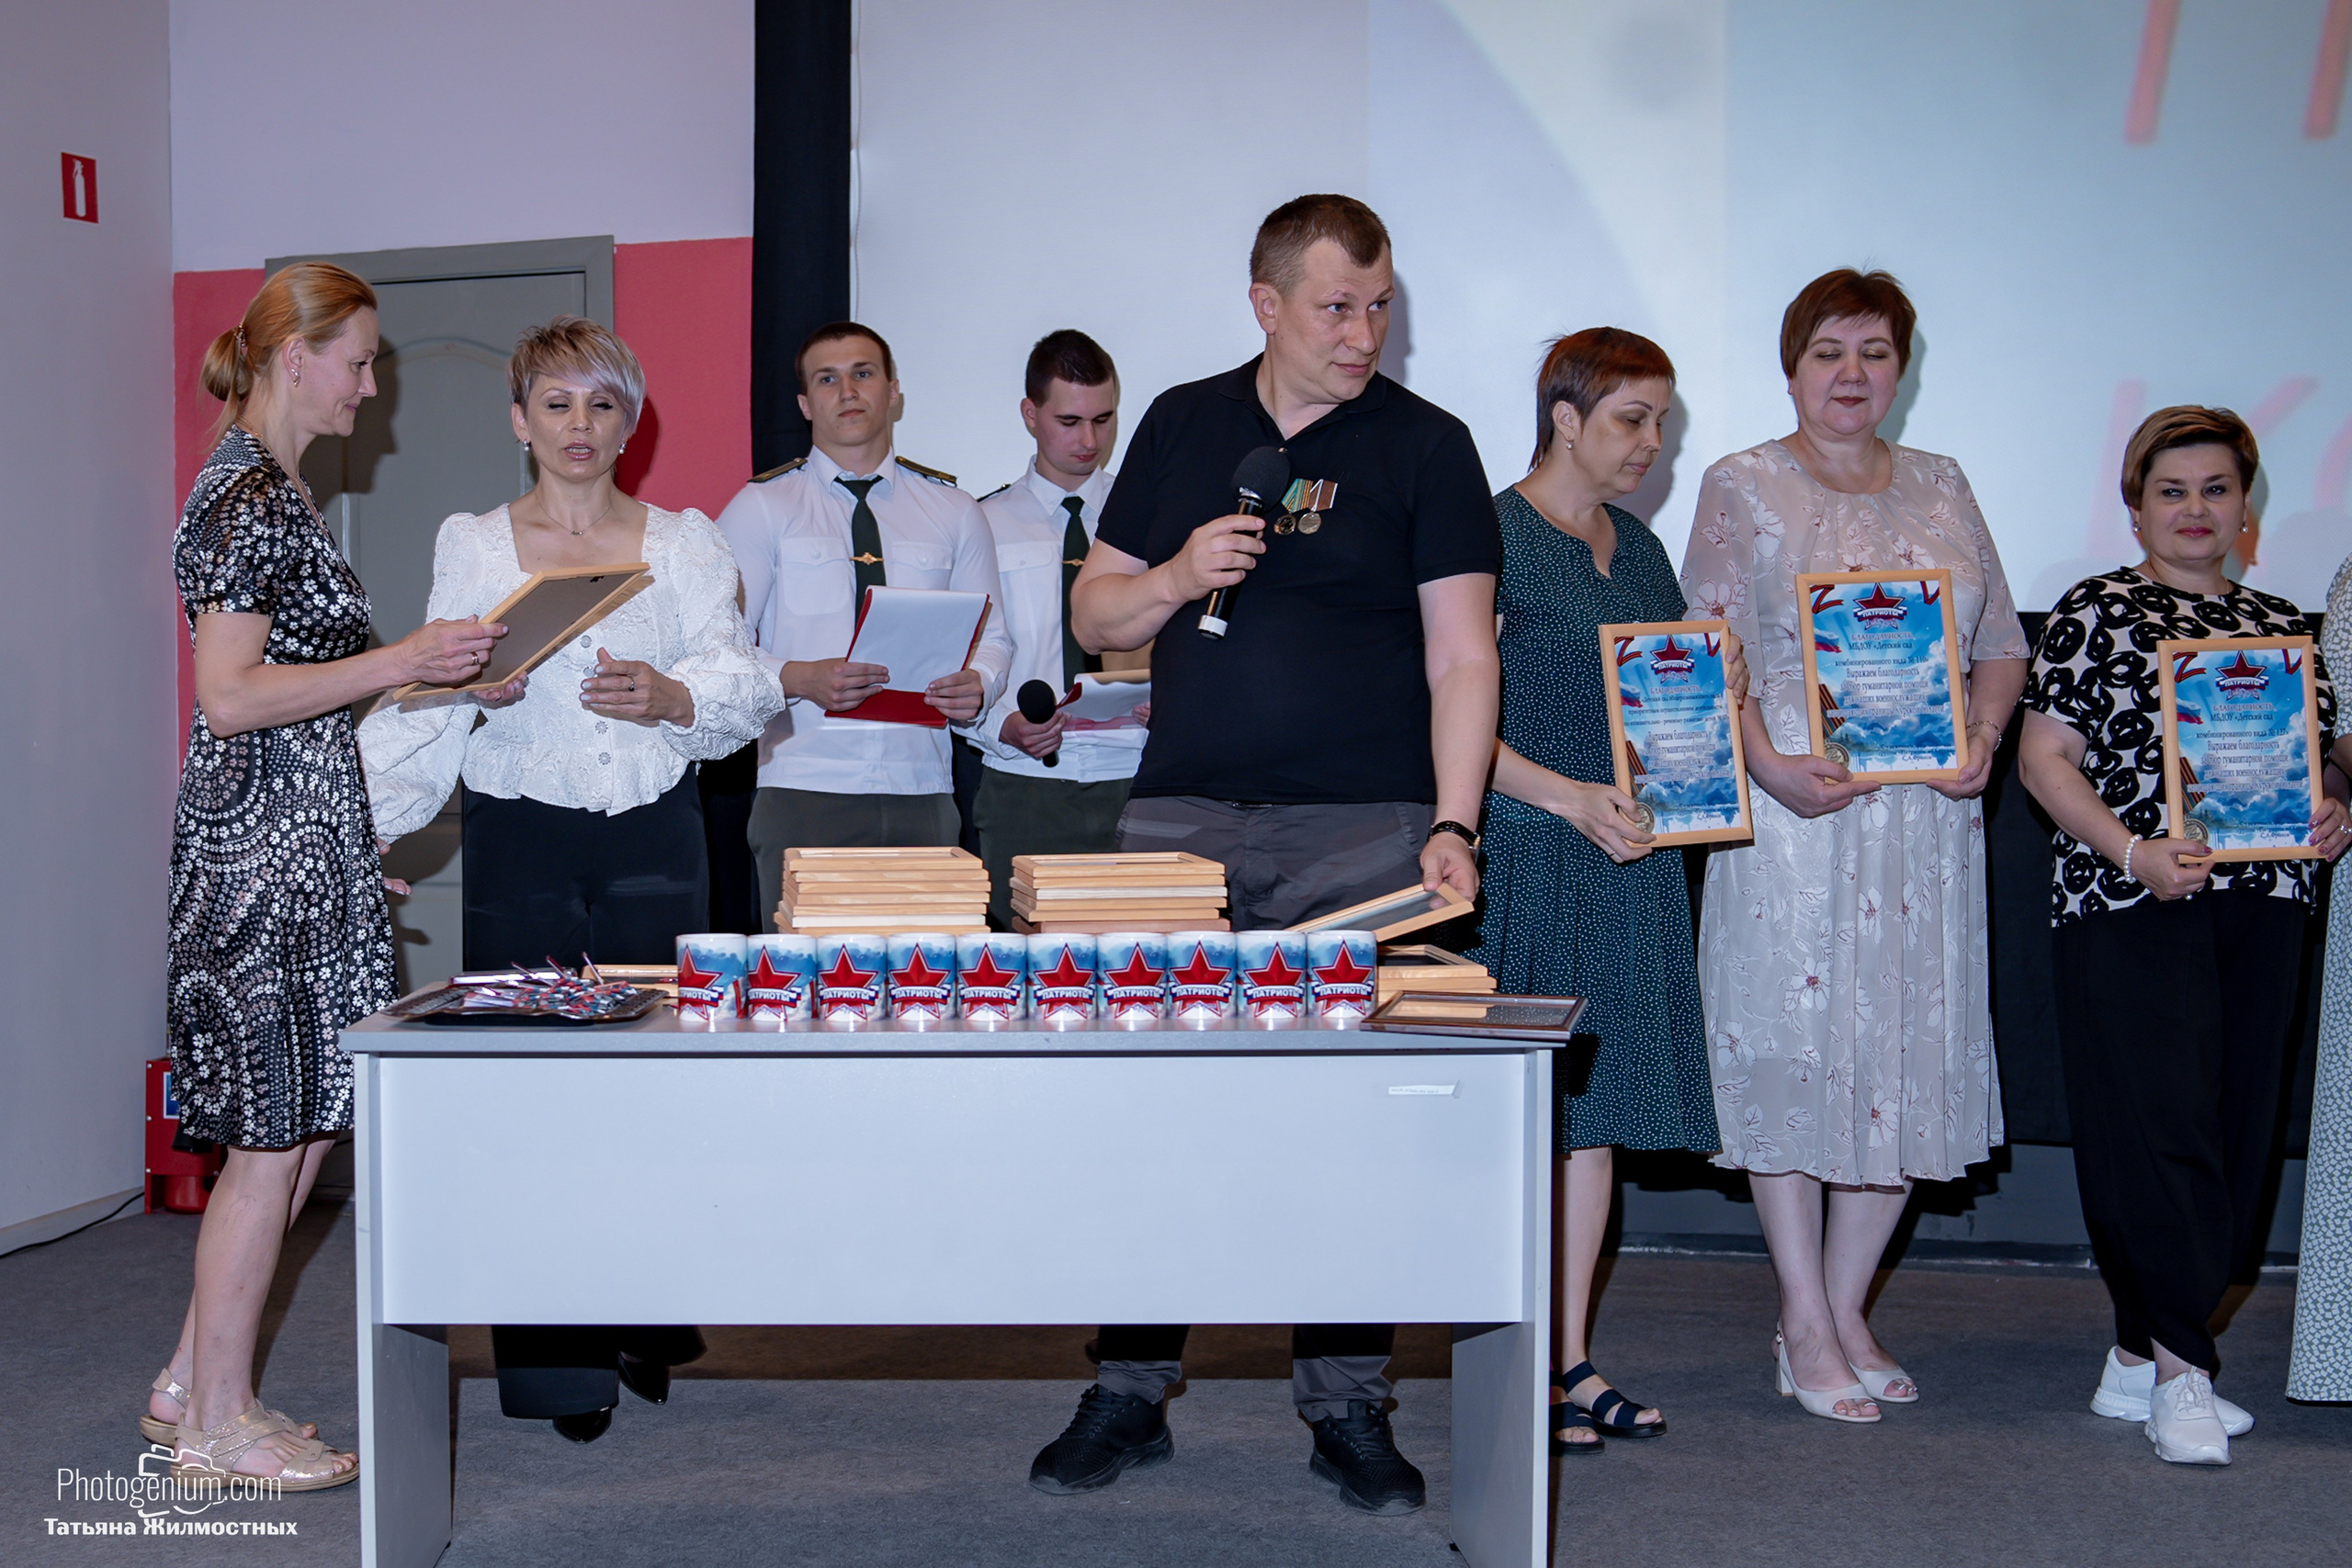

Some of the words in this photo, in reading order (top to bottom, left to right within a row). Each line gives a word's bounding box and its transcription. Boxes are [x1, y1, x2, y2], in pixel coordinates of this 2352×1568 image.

[1862, 609, 1899, 617] ПАТРИОТЫ
[1873, 641, 1902, 650] «Детский
[1658, 661, 1689, 670] ПАТРИОТЫ
[1835, 658, 1892, 667] комбинированного
[1846, 669, 1877, 679] Выражаем
[1877, 667, 1920, 678] благодарность
[1861, 681, 1903, 693] гуманитарной
[2224, 678, 2261, 687] ПАТРИОТЫ
[2210, 714, 2233, 722] МБДОУ
[2234, 713, 2262, 722] «Детский
[2196, 729, 2252, 739] комбинированного
[2207, 741, 2237, 752] Выражаем
[2238, 739, 2280, 751] благодарность
[823, 989, 870, 1000] ПАТРИОТЫ
[895, 988, 943, 999] ПАТРИОТЫ
[964, 988, 1012, 999] ПАТРИОТЫ
[1042, 988, 1090, 999] ПАТРИОТЫ
[1113, 988, 1161, 999] ПАТРИОТЫ
[1176, 987, 1225, 998] ПАТРИОТЫ
[1252, 987, 1300, 999] ПАТРИОТЫ
[1319, 987, 1368, 997] ПАТРИОТЫ
